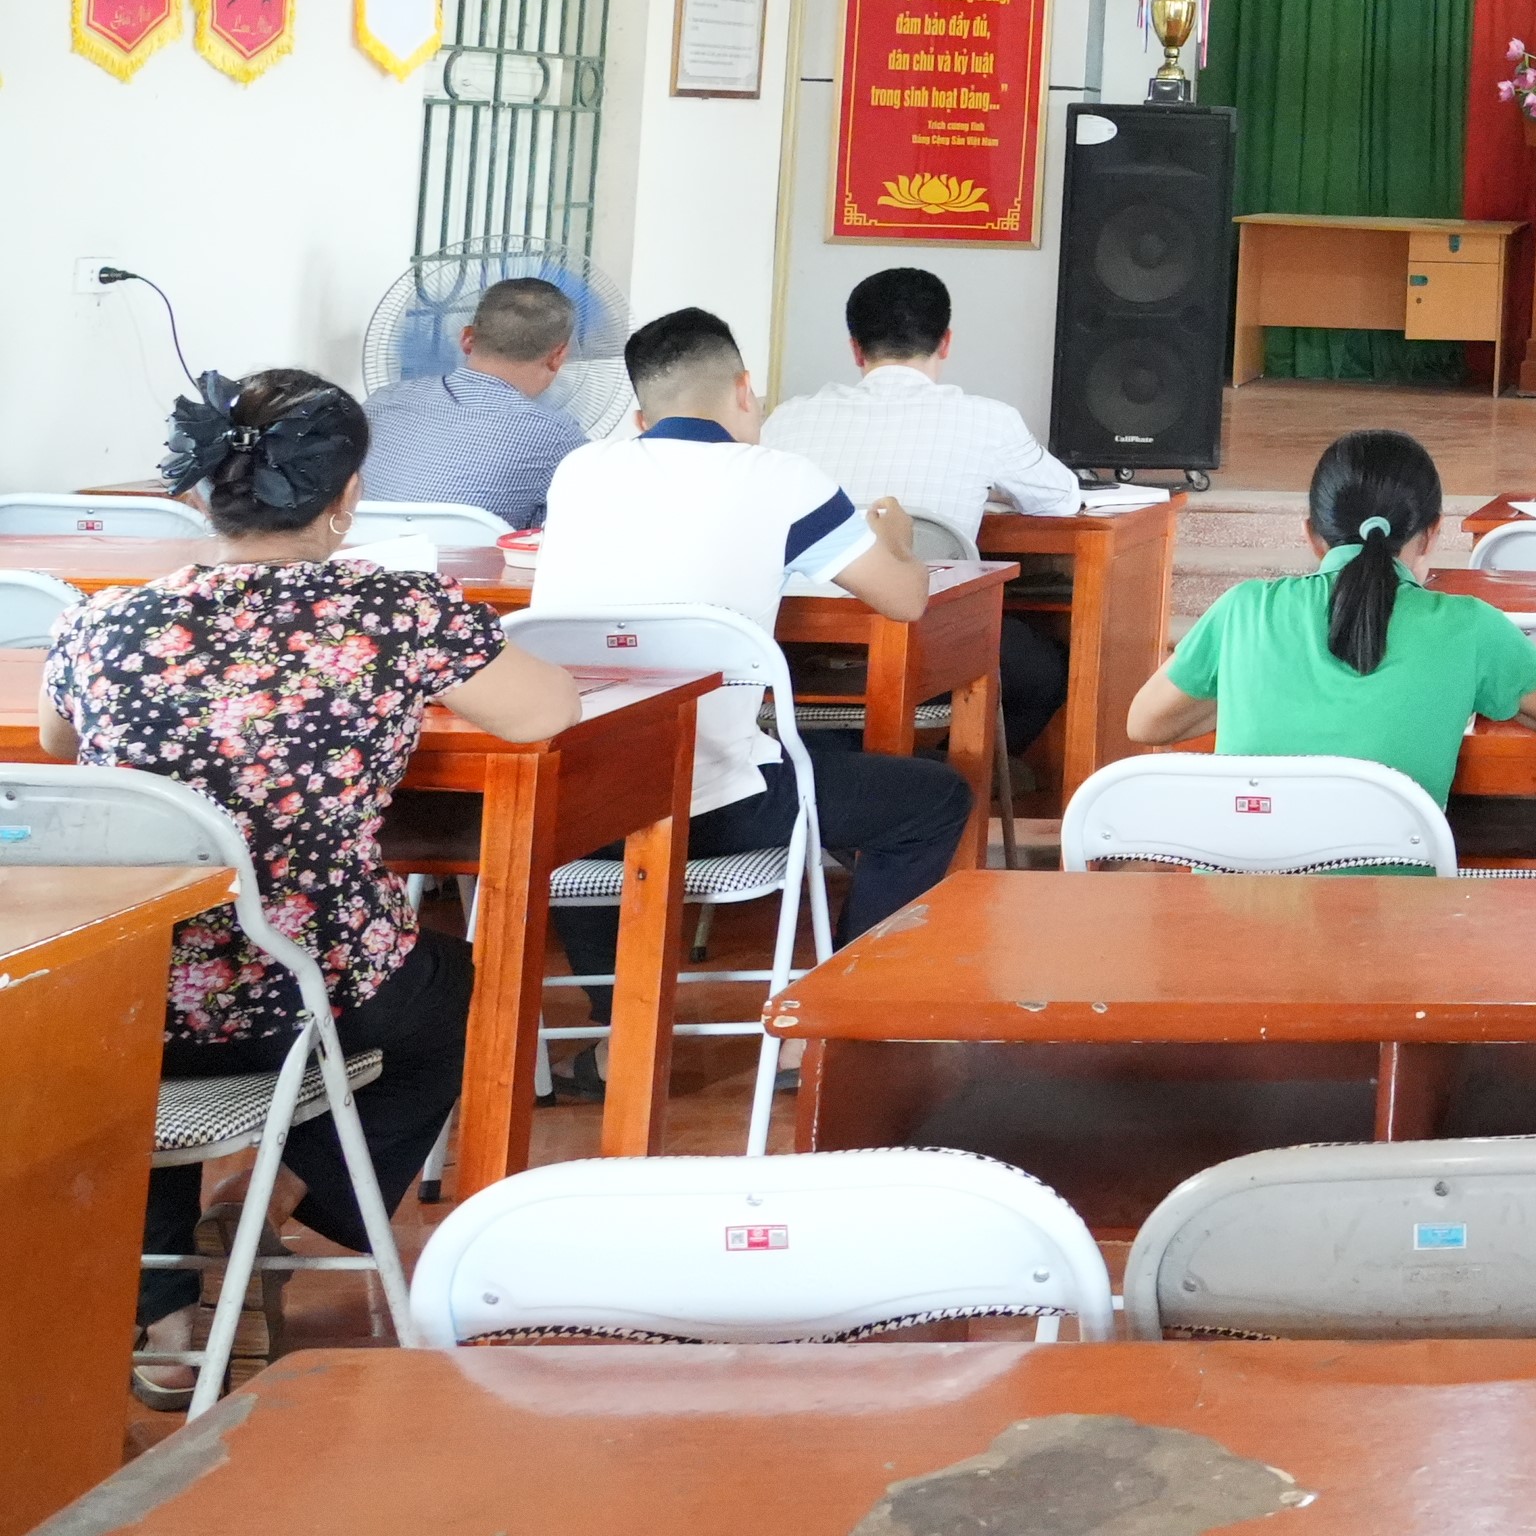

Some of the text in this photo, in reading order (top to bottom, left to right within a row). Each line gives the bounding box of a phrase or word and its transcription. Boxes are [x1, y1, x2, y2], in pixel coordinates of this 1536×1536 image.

[896, 11, 921, 35] đảm
[924, 11, 945, 36] bảo
[888, 46, 994, 79] dân chủ và kỷ luật
[871, 85, 901, 109] trong
[904, 86, 929, 108] sinh
[932, 86, 957, 113] hoạt
